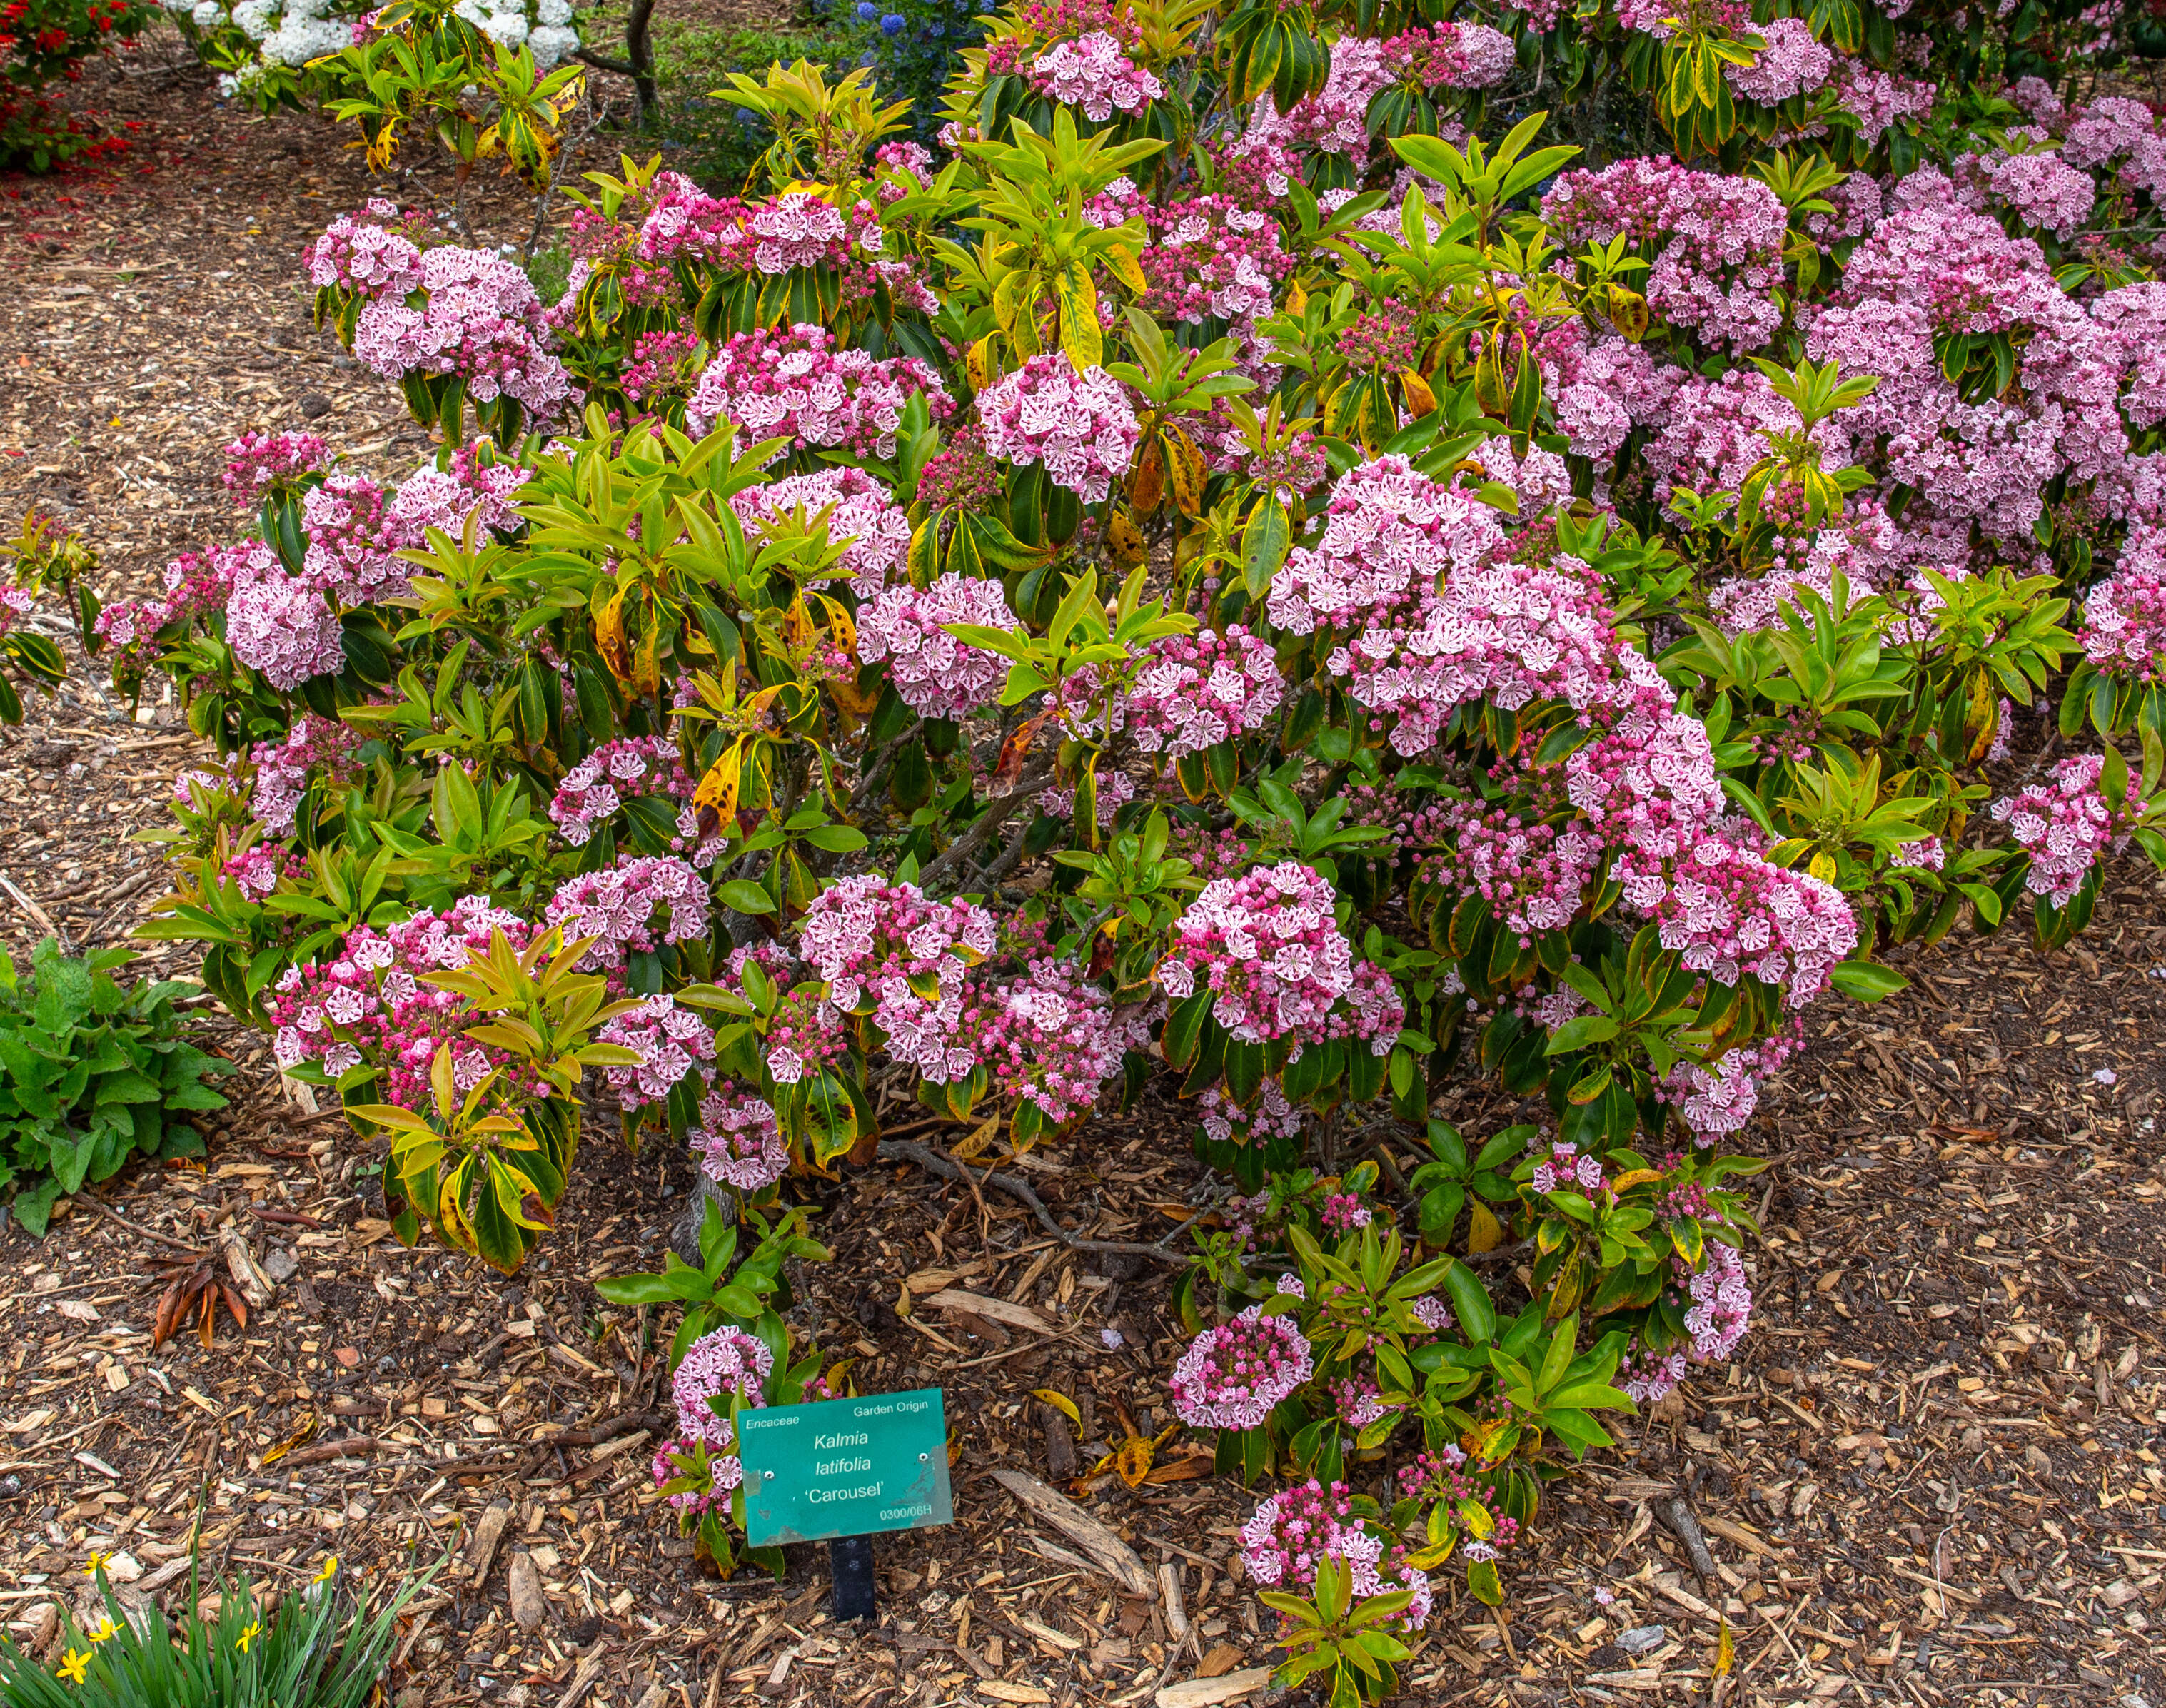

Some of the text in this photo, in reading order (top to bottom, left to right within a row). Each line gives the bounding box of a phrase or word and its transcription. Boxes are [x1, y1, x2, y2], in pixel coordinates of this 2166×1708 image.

[853, 1400, 928, 1417] Garden Origin
[746, 1416, 800, 1430] Ericaceae
[814, 1431, 868, 1450] Kalmia
[815, 1457, 871, 1475] latifolia
[880, 1504, 932, 1520] 0300/06H
